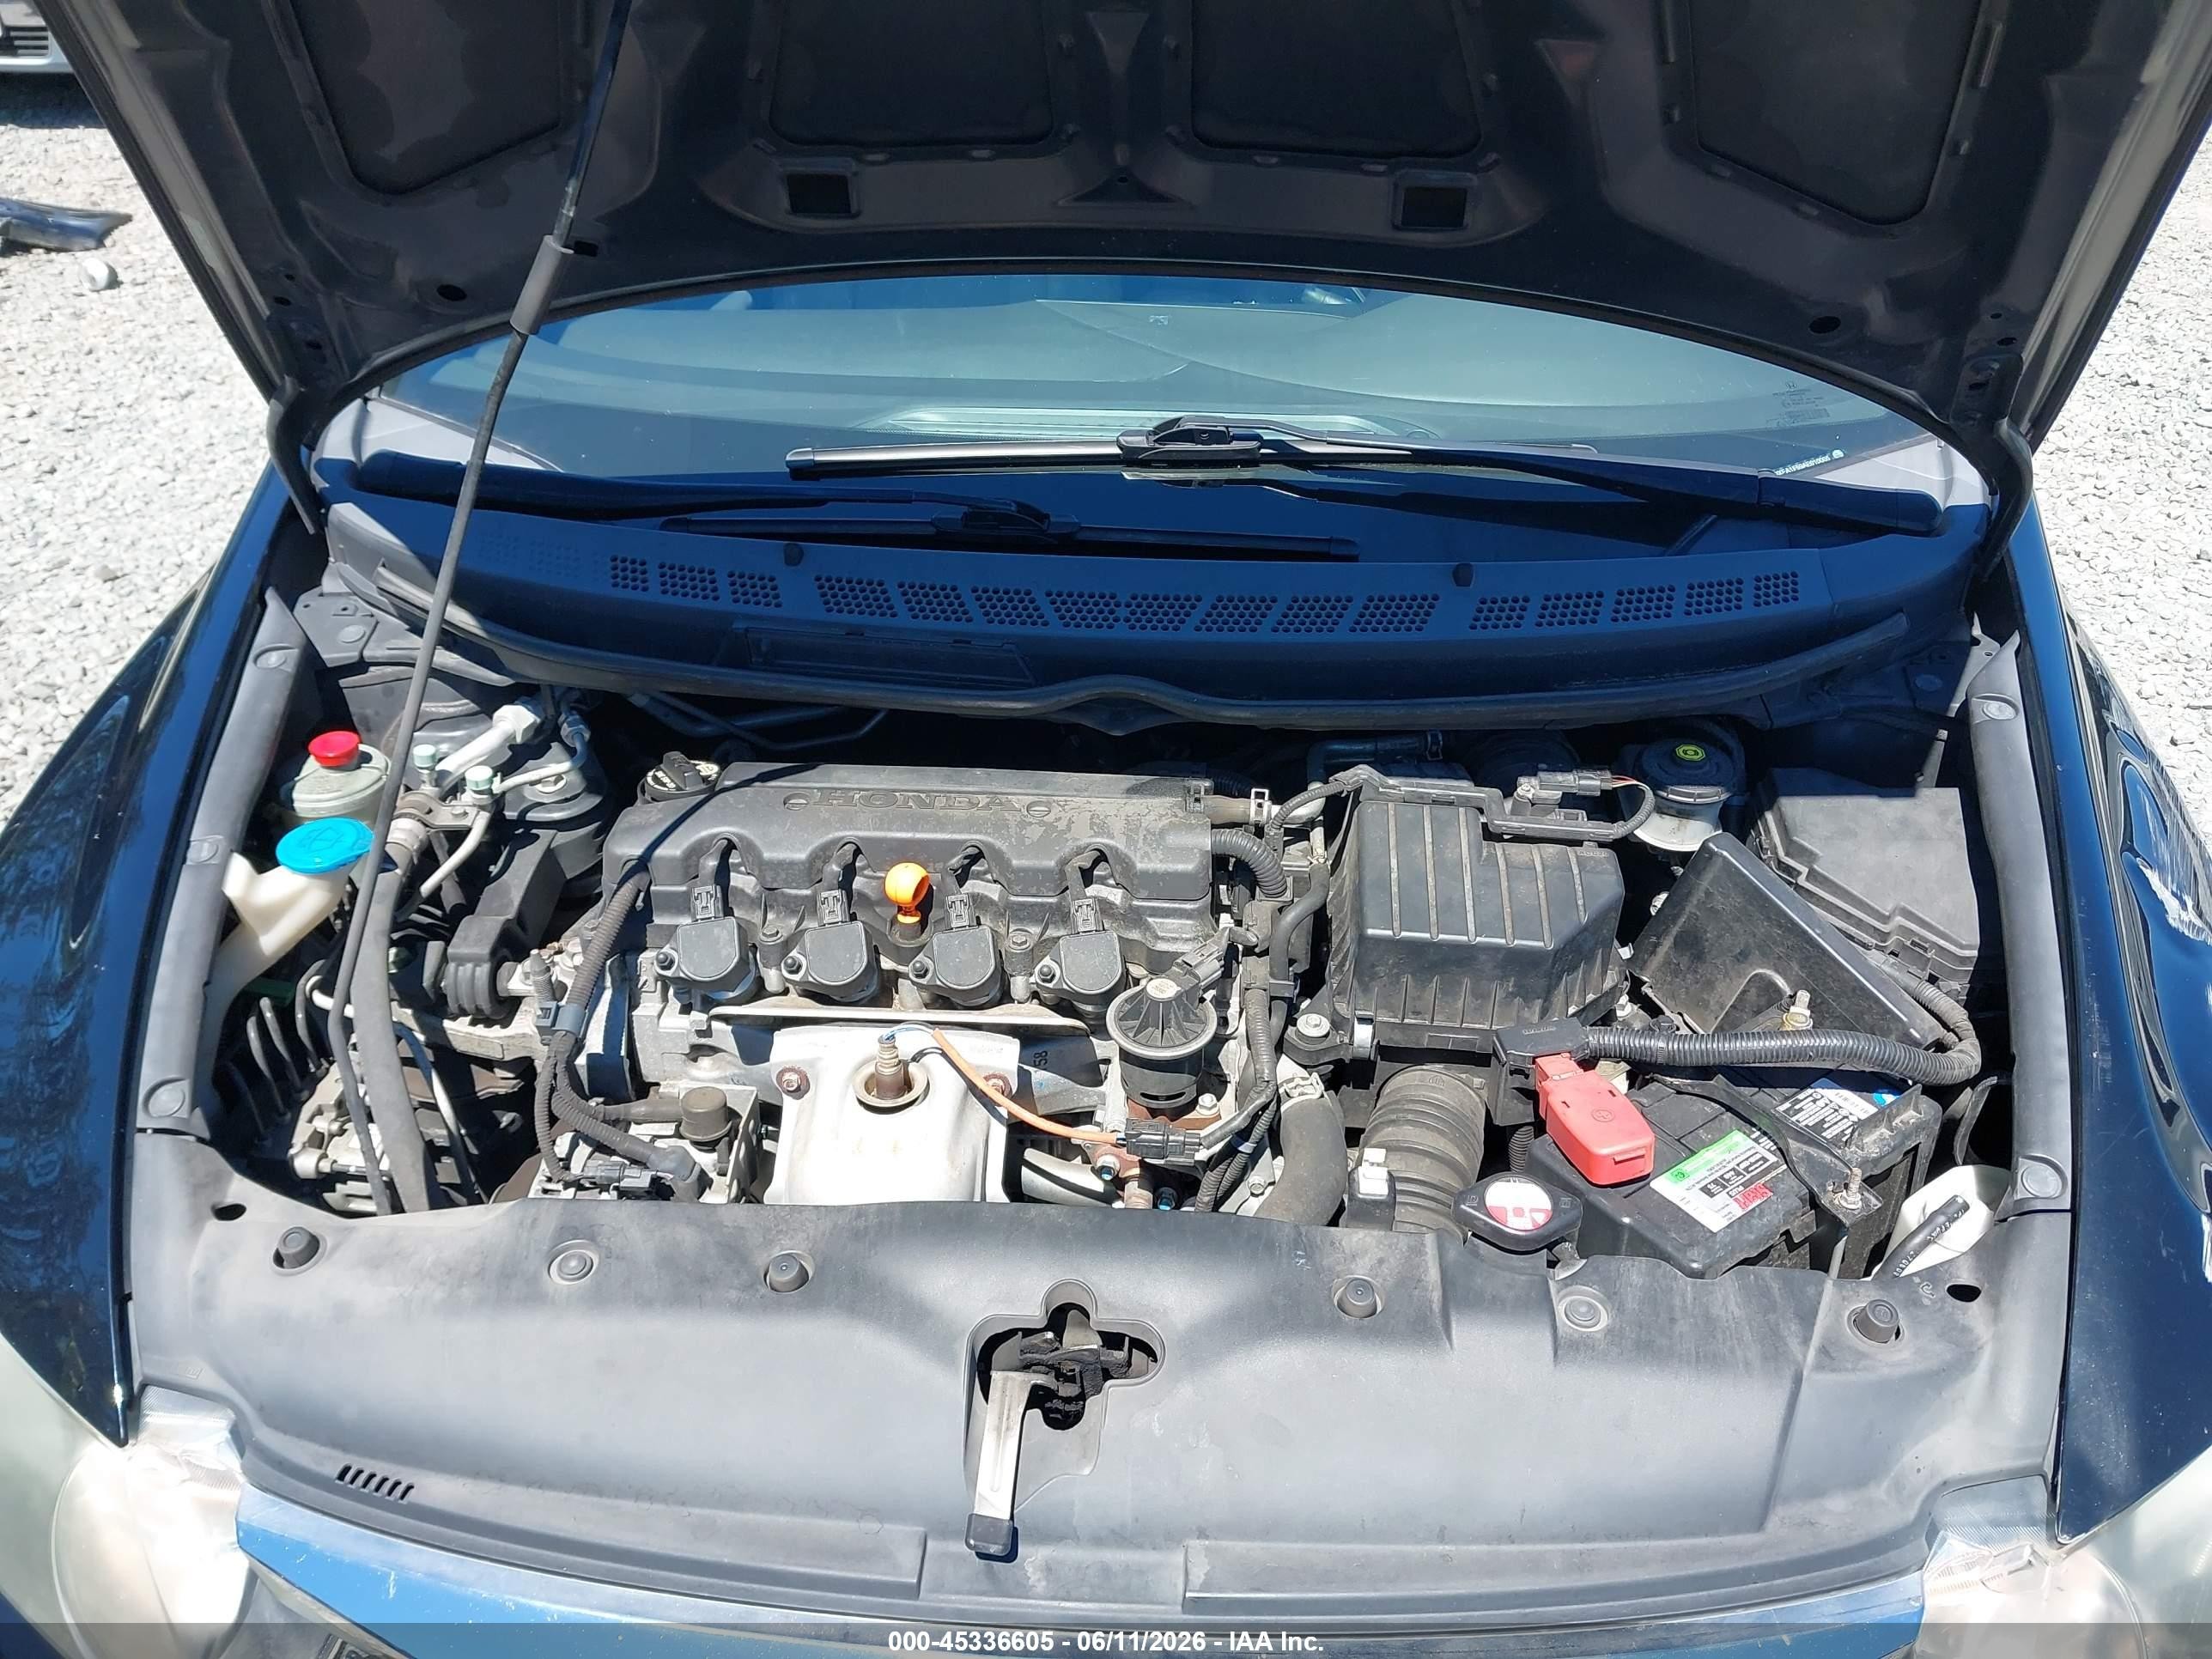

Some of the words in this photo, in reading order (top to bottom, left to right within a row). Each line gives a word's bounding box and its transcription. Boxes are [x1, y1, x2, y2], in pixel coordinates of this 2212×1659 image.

[814, 789, 1022, 812] HONDA
[1033, 1050, 1048, 1070] 58
[1729, 1186, 1745, 1198] PLUS
